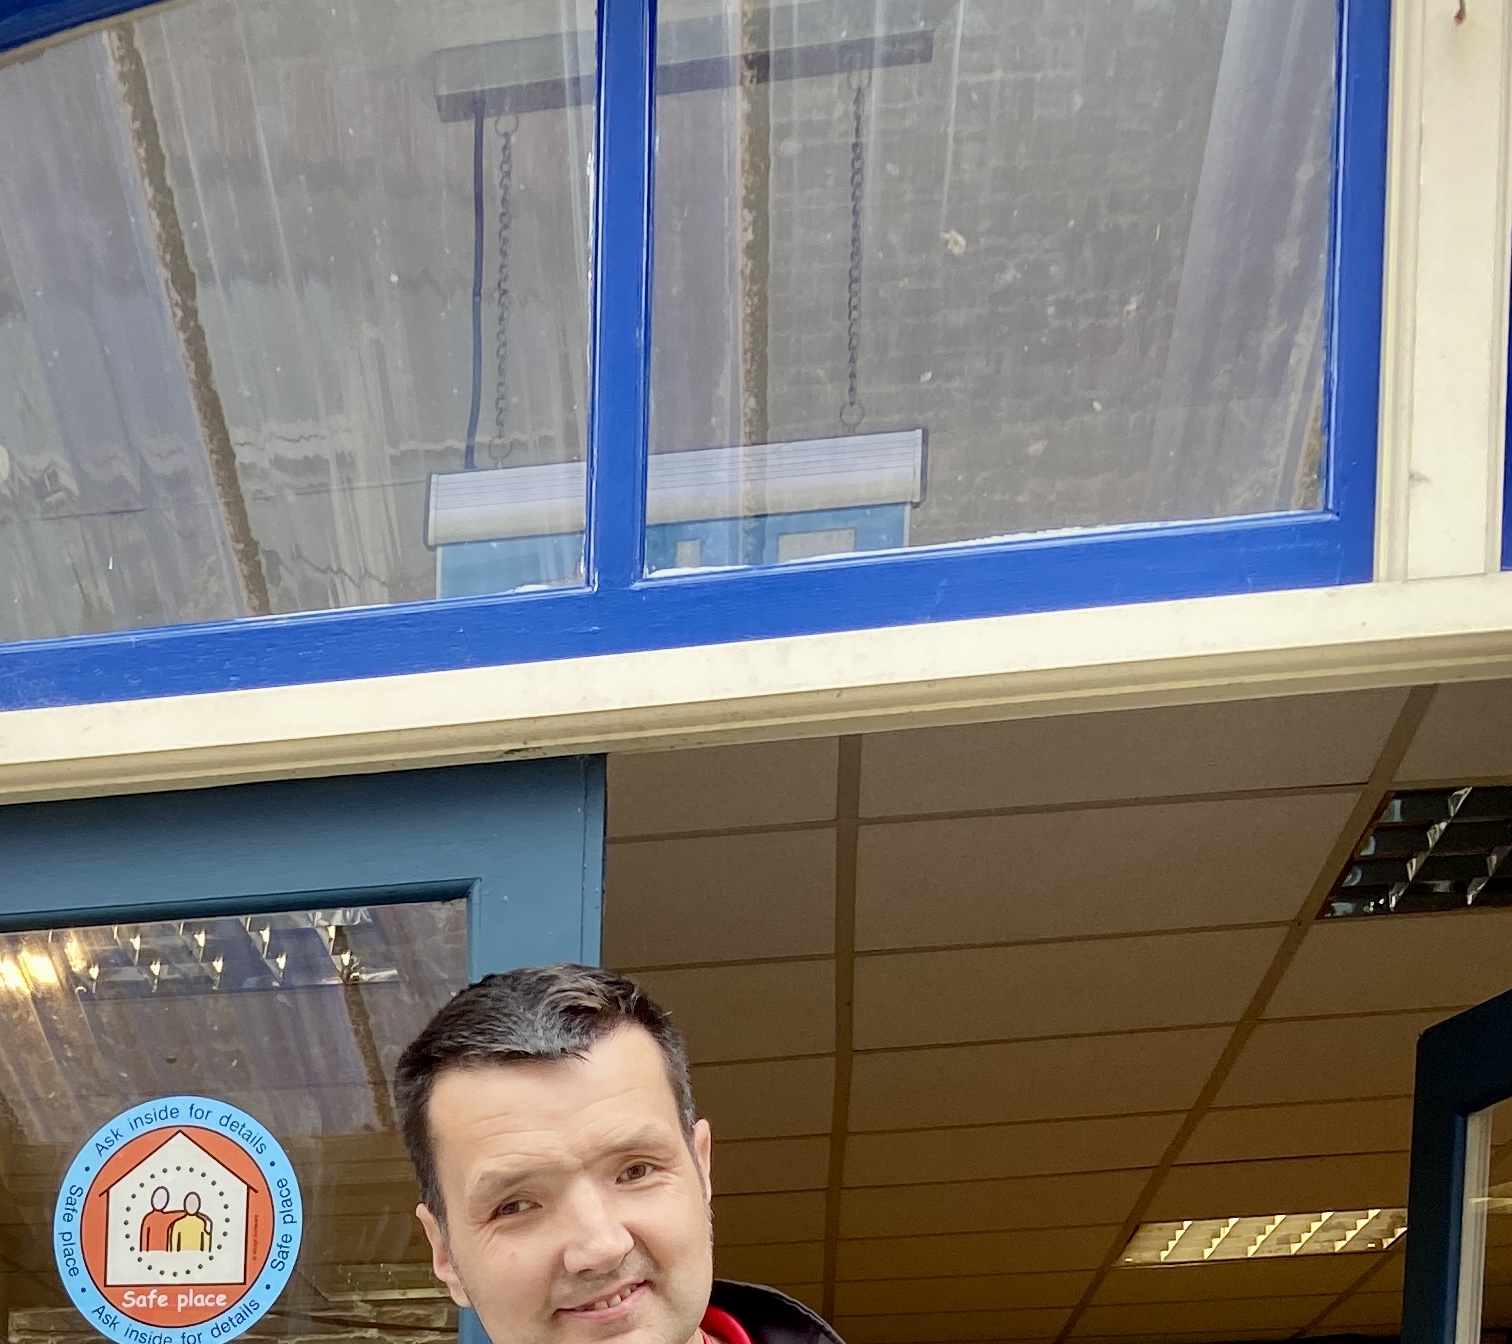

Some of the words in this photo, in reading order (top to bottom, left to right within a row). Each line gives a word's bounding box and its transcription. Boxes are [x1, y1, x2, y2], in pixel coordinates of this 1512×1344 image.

[94, 1127, 124, 1157] Ask
[127, 1104, 180, 1131] inside
[188, 1103, 212, 1121] for
[218, 1113, 268, 1156] details
[61, 1183, 84, 1224] Safe
[276, 1177, 297, 1225] place
[58, 1230, 80, 1278] place
[270, 1232, 294, 1272] Safe
[91, 1304, 121, 1332] Ask
[210, 1298, 261, 1340] details
[121, 1288, 169, 1309] Safe
[177, 1288, 228, 1312] place
